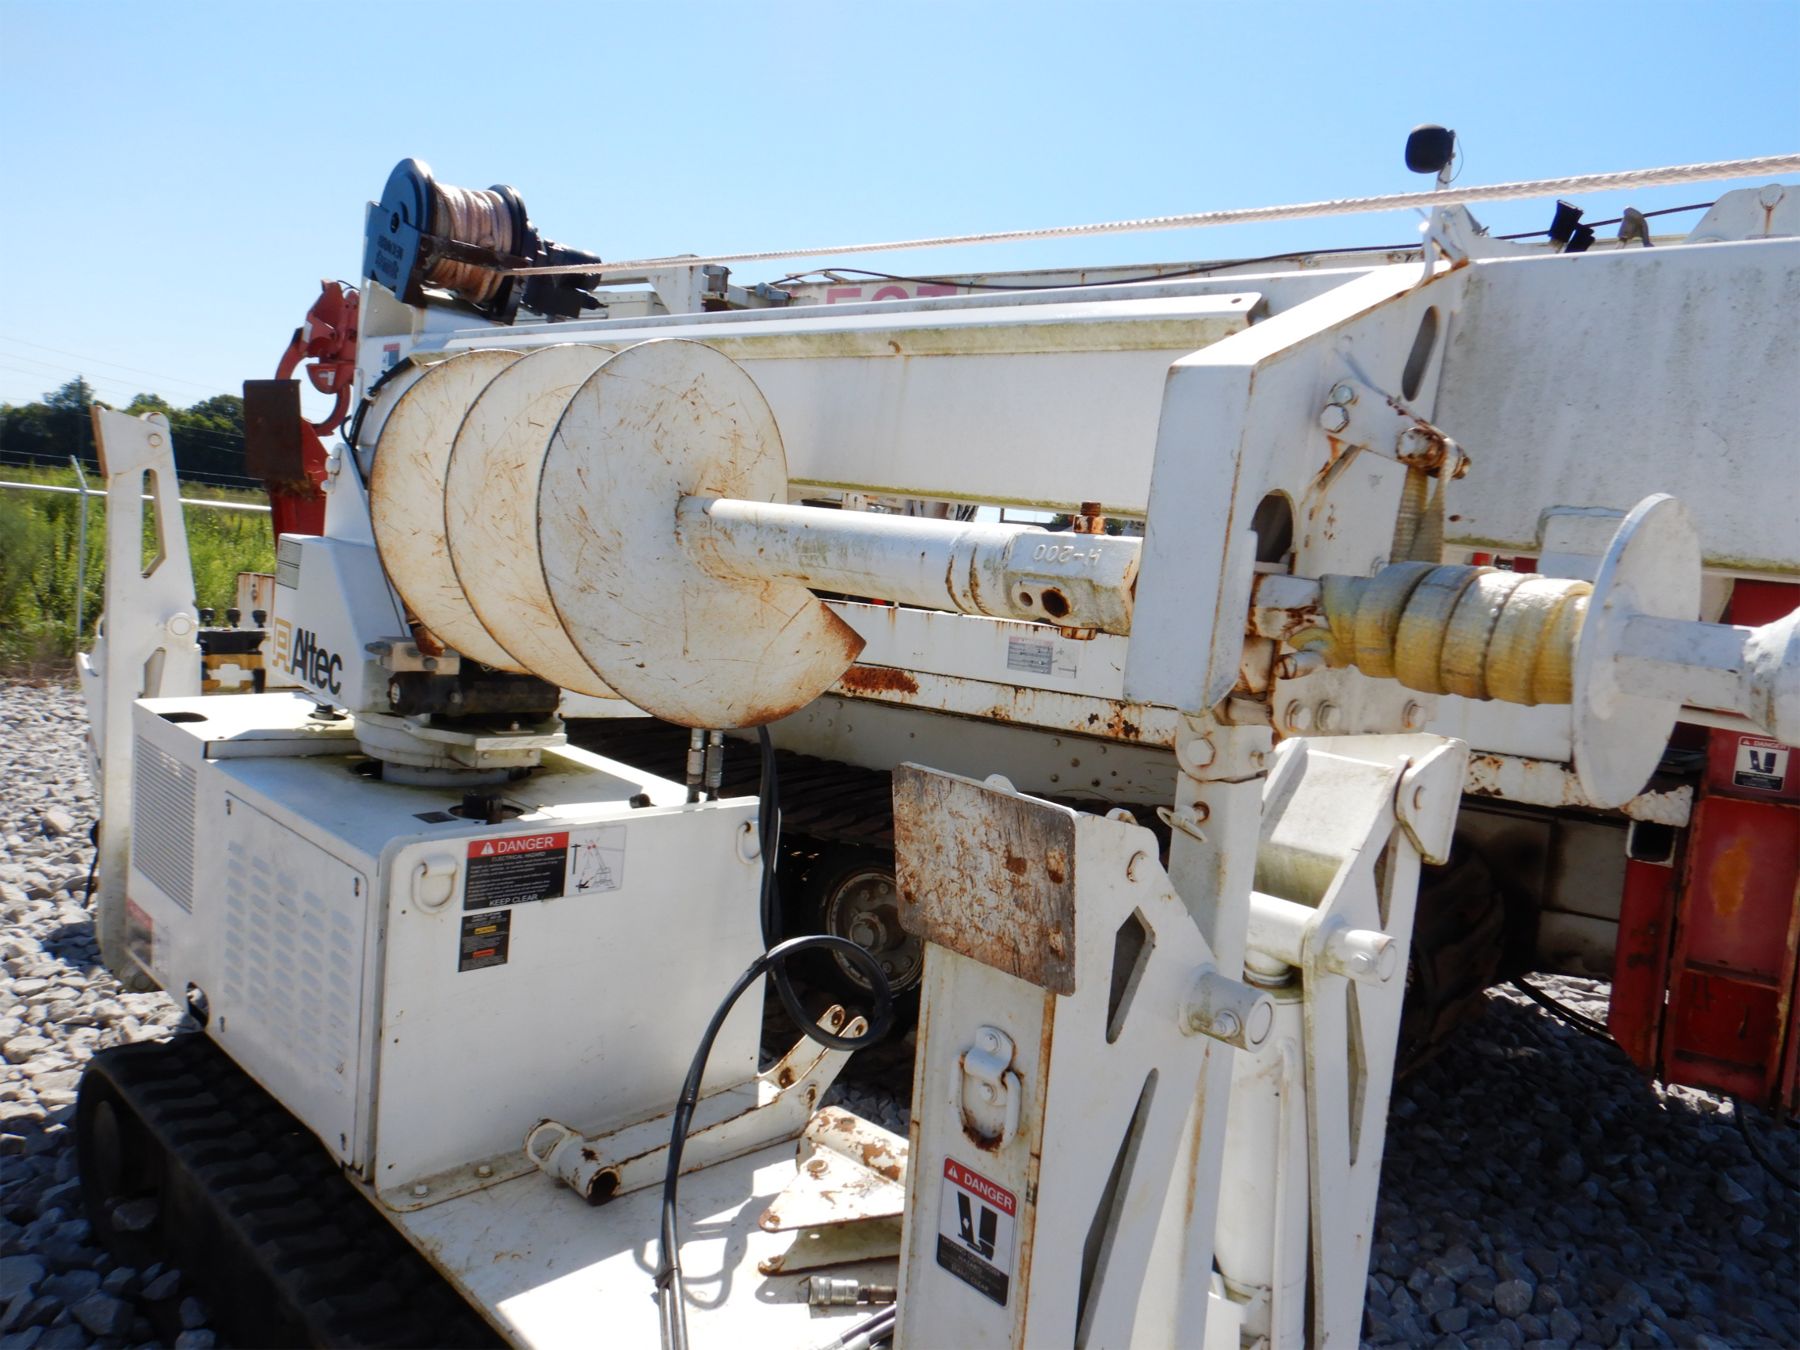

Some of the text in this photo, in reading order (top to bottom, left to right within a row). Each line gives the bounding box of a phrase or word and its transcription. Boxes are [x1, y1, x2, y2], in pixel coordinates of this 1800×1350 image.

[291, 627, 343, 695] Altec
[1753, 740, 1787, 750] DANGER
[498, 836, 554, 854] DANGER
[489, 897, 511, 907] KEEP
[512, 894, 539, 904] CLEAR
[964, 1172, 1013, 1210] DANGER
